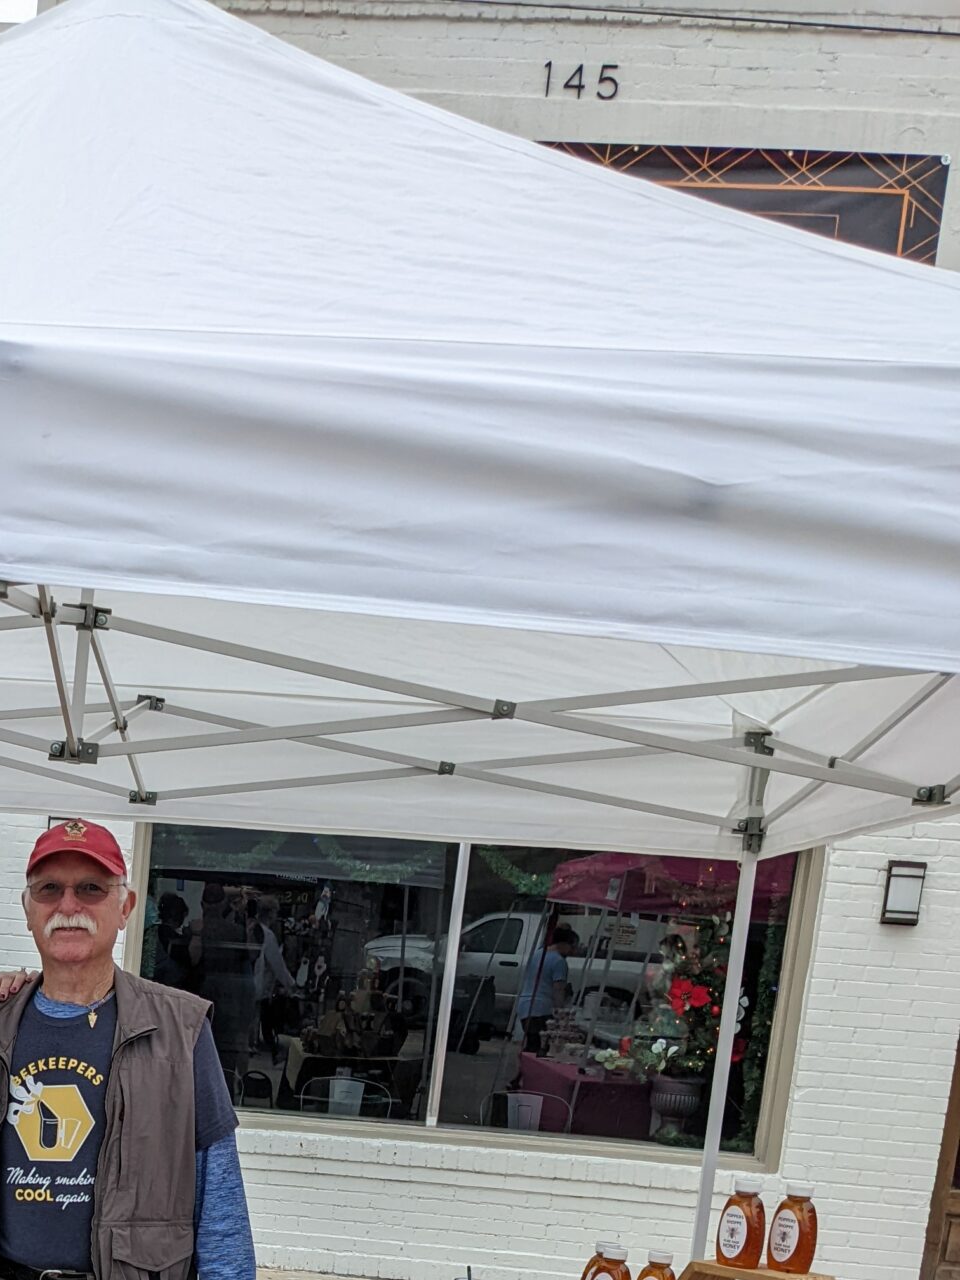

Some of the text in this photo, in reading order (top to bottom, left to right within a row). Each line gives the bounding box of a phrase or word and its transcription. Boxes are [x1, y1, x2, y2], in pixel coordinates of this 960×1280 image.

[544, 61, 619, 100] 145
[12, 1057, 104, 1086] BEEKEEPERS
[6, 1166, 52, 1191] Making
[15, 1188, 90, 1210] COOL again
